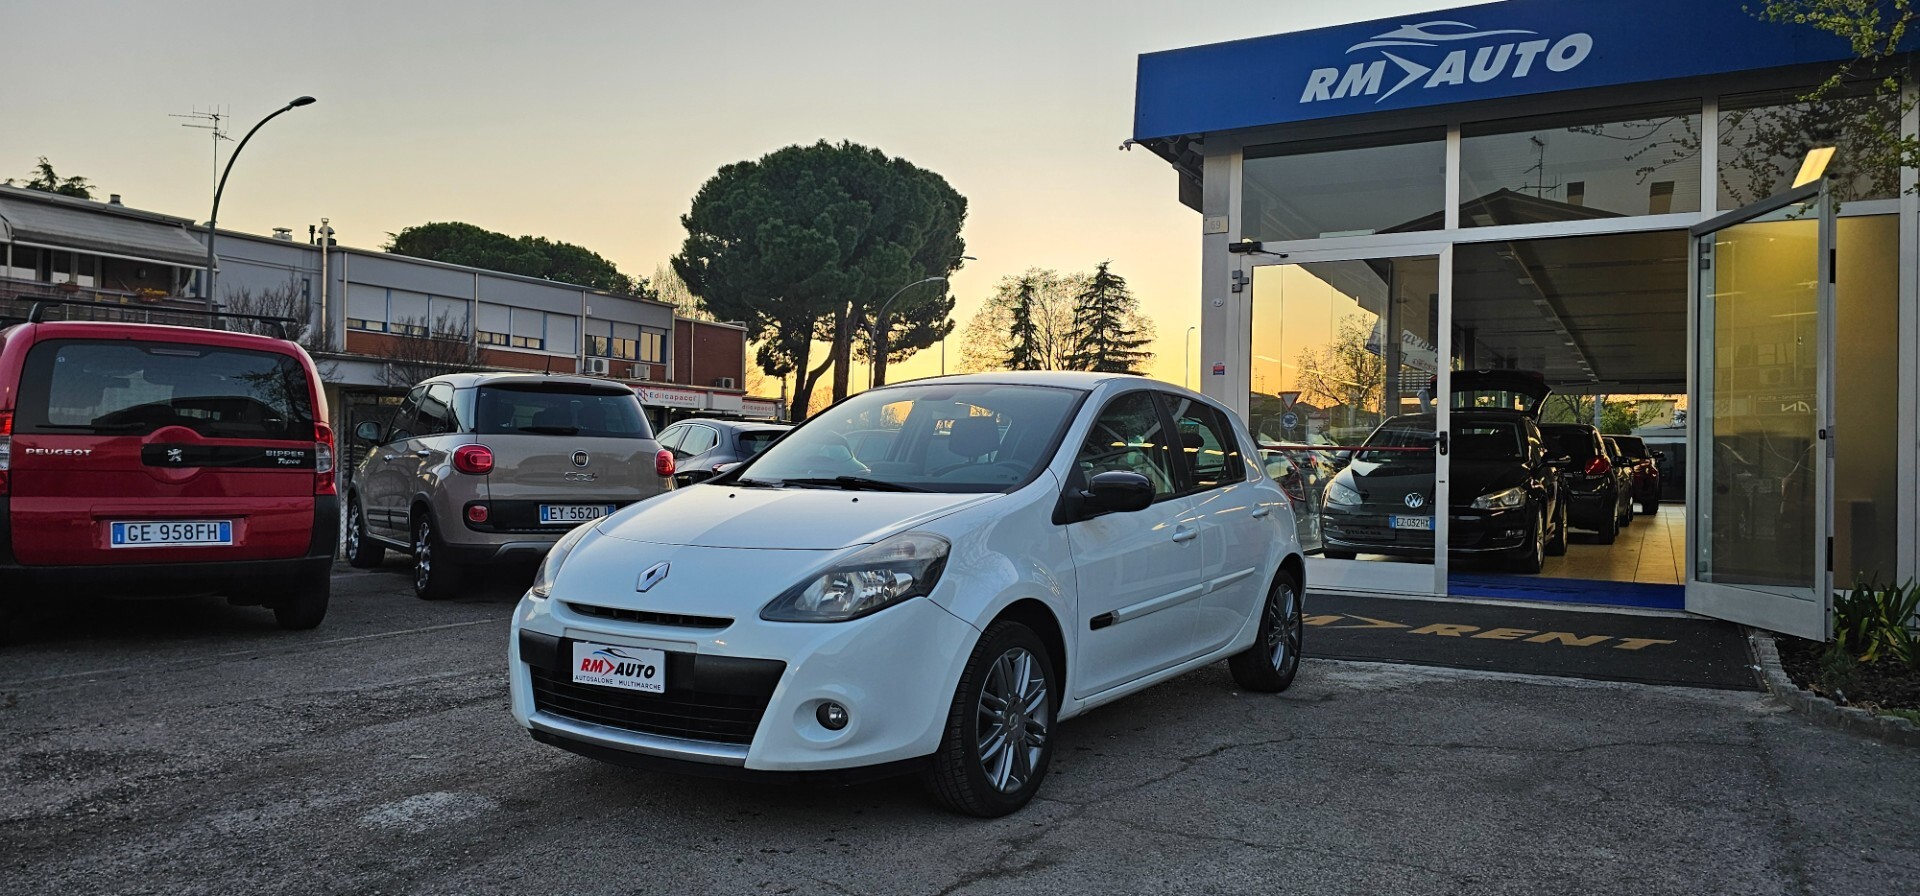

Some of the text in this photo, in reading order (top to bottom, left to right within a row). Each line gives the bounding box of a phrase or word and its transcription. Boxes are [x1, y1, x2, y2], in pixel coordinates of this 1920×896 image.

[1423, 32, 1594, 89] AUTO
[1210, 220, 1221, 231] 69
[25, 447, 92, 456] PEUGEOT
[265, 449, 305, 458] BIPPER
[128, 524, 152, 542] GE
[159, 523, 218, 541] 958FH
[1406, 623, 1678, 650] RENT
[580, 657, 656, 680] RM AUTO
[574, 674, 662, 691] AUTOSALONE MULTIMARCHE
